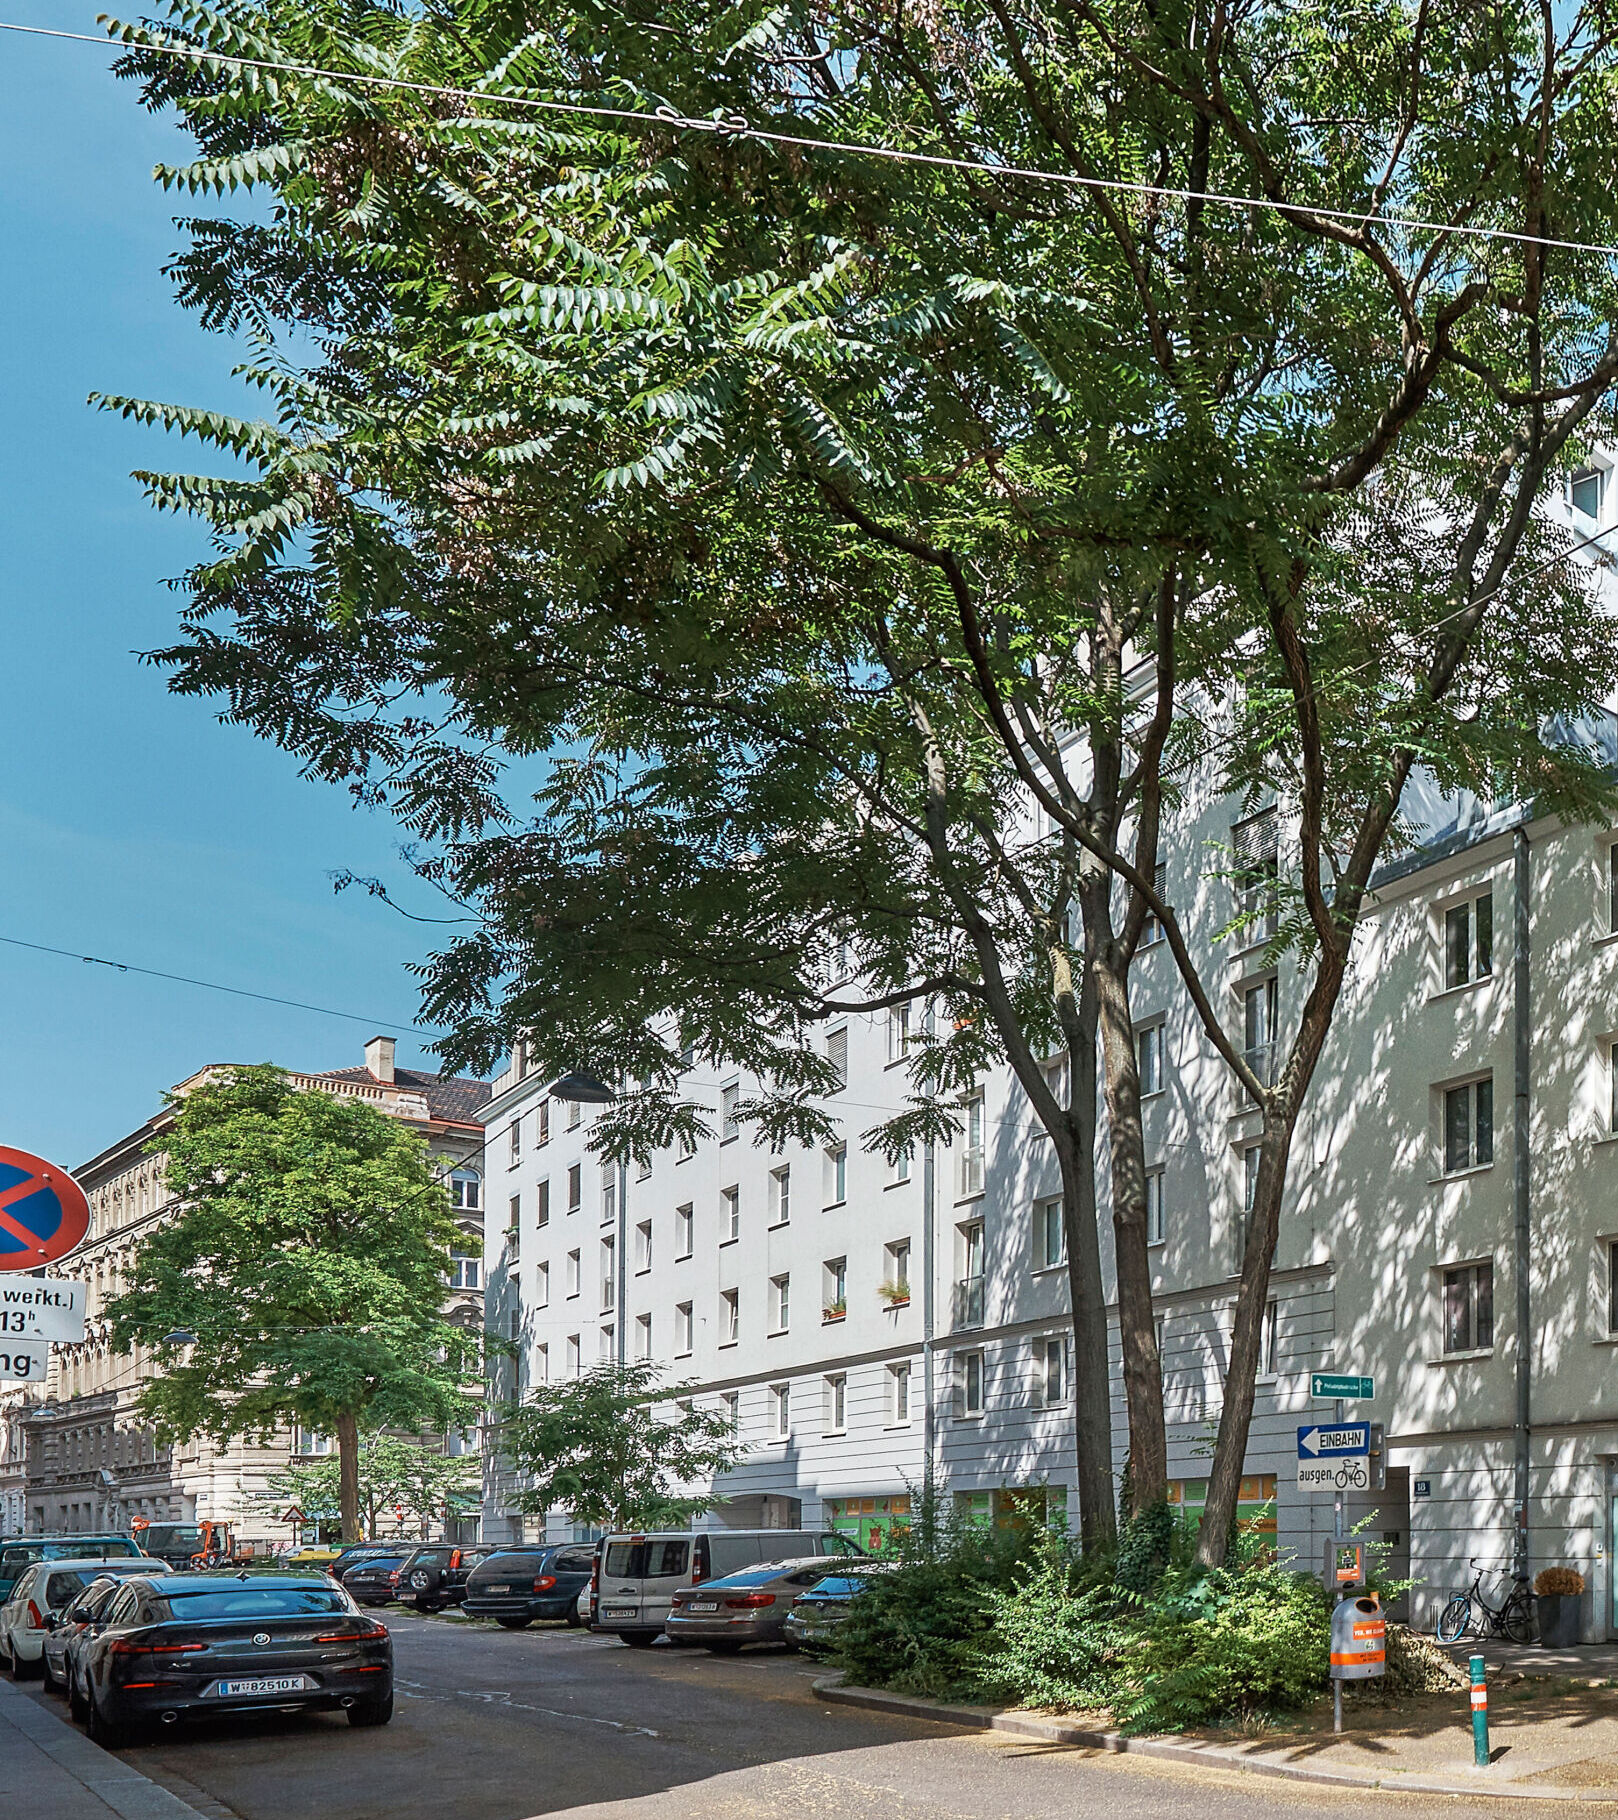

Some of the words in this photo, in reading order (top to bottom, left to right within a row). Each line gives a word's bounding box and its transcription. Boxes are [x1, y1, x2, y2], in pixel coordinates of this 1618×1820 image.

[1320, 1431, 1361, 1448] EINBAHN
[1299, 1469, 1335, 1484] ausgen.
[1417, 1482, 1426, 1491] 18
[231, 1684, 240, 1692] W
[250, 1680, 289, 1691] 82510
[291, 1679, 299, 1688] K
